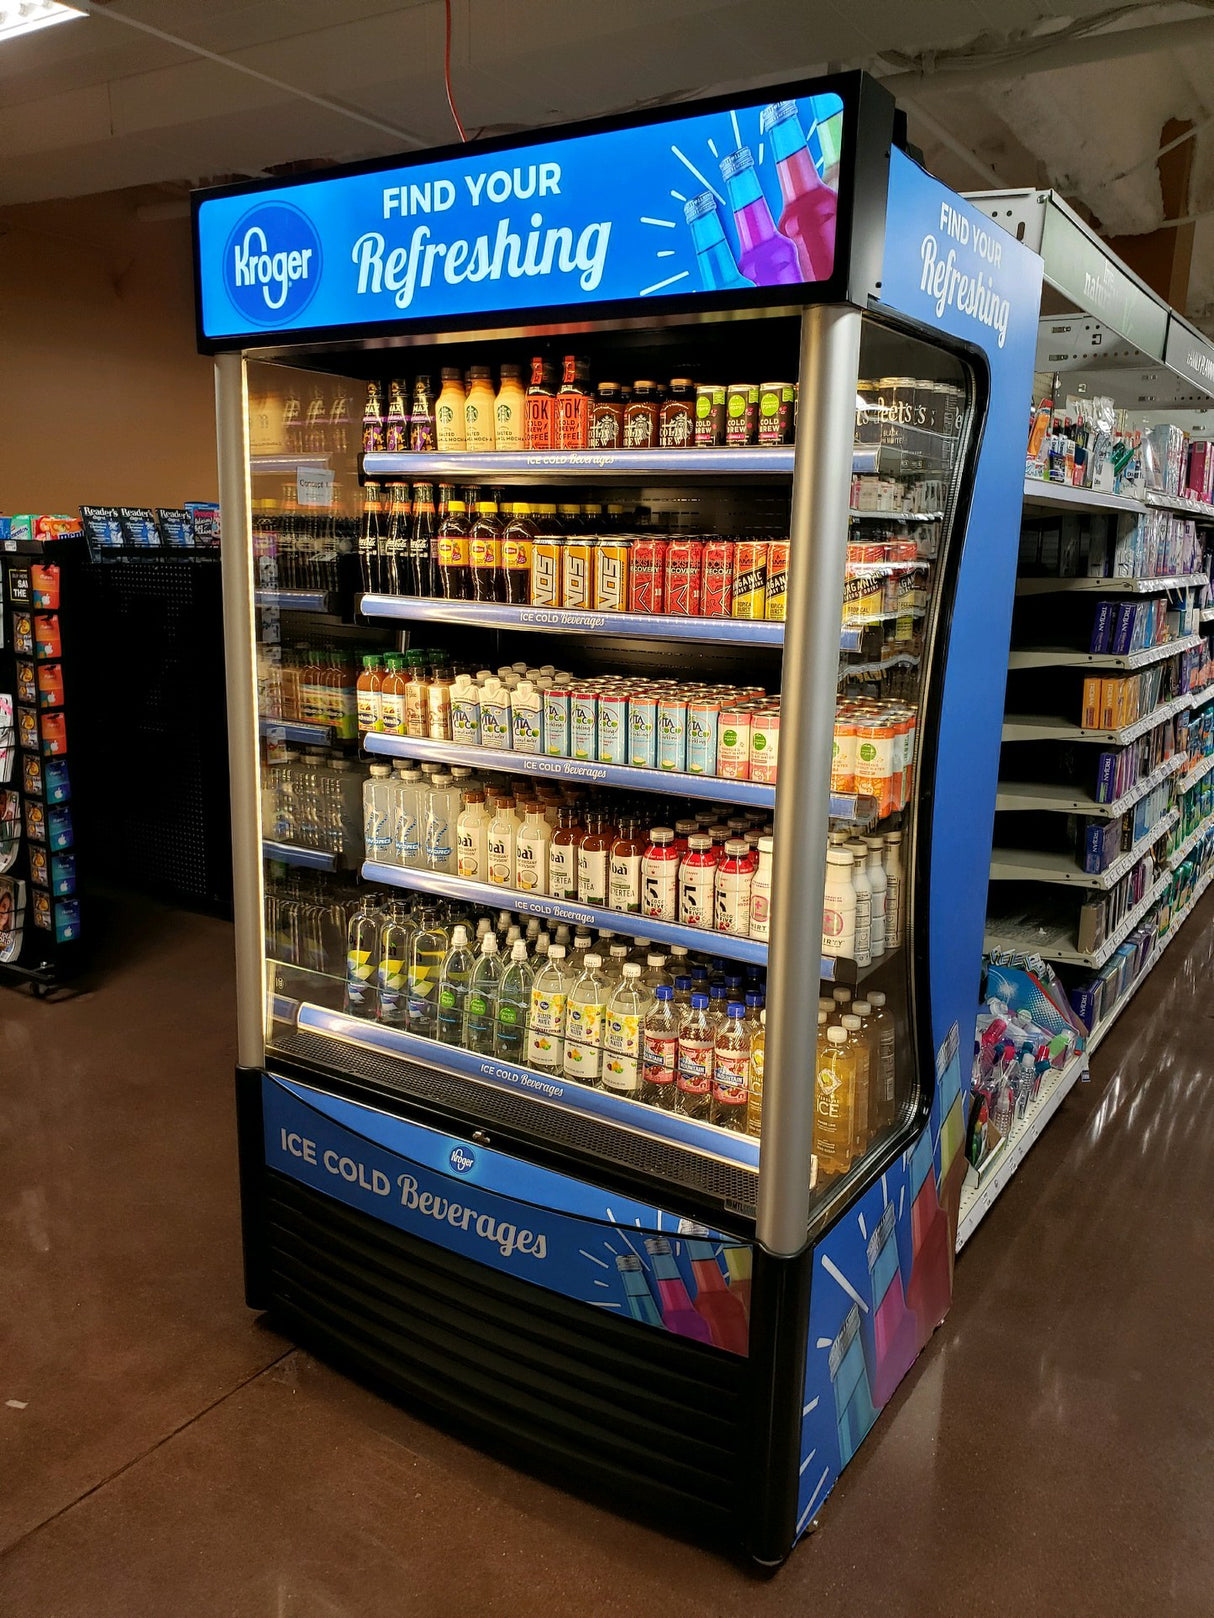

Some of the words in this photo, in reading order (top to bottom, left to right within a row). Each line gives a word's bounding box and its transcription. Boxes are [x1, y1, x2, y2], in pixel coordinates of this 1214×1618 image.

[383, 181, 455, 219] FIND
[468, 162, 562, 206] YOUR
[939, 202, 970, 245] FIND
[972, 227, 1003, 269] YOUR
[234, 227, 313, 310] Kroger
[351, 213, 612, 309] Refreshing
[920, 234, 1011, 349] Refreshing
[760, 418, 779, 426] COLD
[760, 425, 780, 433] BREW
[527, 456, 541, 465] ICE
[543, 455, 567, 465] COLD
[567, 453, 615, 467] Beverages
[83, 506, 119, 518] Reader's
[121, 507, 154, 519] Reader's
[160, 509, 192, 520] Reader's
[59, 530, 85, 540] ment
[533, 551, 554, 606] NOS
[563, 551, 585, 608] NOS
[599, 553, 621, 611] NOS
[520, 612, 534, 622] ICE
[535, 613, 559, 623] COLD
[560, 613, 605, 628] Beverages
[1099, 606, 1108, 632] TROJAN
[1122, 606, 1131, 632] TROJAN
[523, 760, 537, 769] ICE
[538, 761, 561, 773] COLD
[562, 763, 607, 779] Beverages
[488, 840, 505, 854] bai
[611, 863, 628, 876] bai
[514, 900, 528, 910] ICE
[529, 903, 552, 915] COLD
[553, 905, 595, 924] Beverages
[480, 1064, 494, 1076] ICE
[495, 1069, 519, 1083] COLD
[520, 1073, 564, 1097] Beverages
[816, 1097, 840, 1118] ICE
[450, 1148, 473, 1171] Kroger
[280, 1127, 318, 1166] ICE
[323, 1150, 391, 1196] COLD
[396, 1173, 548, 1260] Beverages
